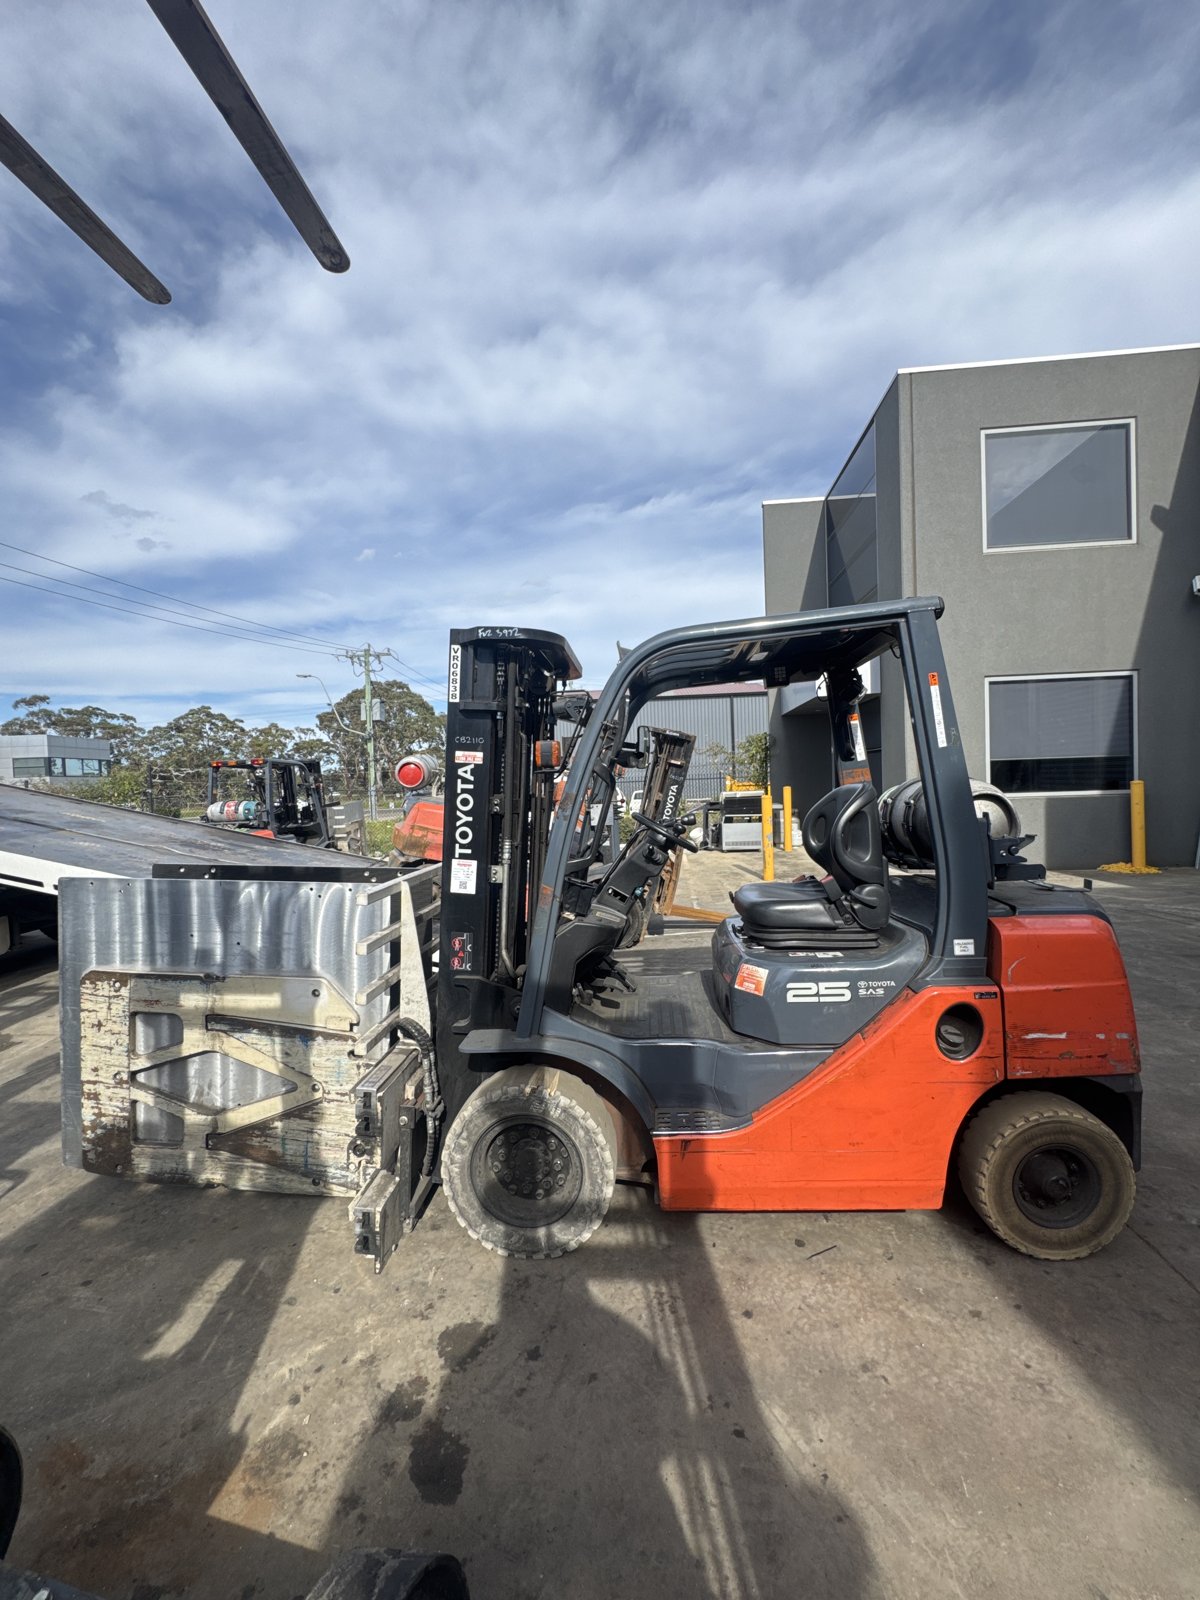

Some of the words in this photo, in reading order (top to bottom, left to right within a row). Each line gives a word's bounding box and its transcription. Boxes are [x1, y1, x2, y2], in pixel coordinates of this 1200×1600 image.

[451, 647, 460, 700] VR06838
[455, 763, 475, 858] TOYOTA
[662, 785, 678, 820] TOYOTA
[786, 982, 852, 1003] 25
[868, 980, 896, 988] TOYOTA
